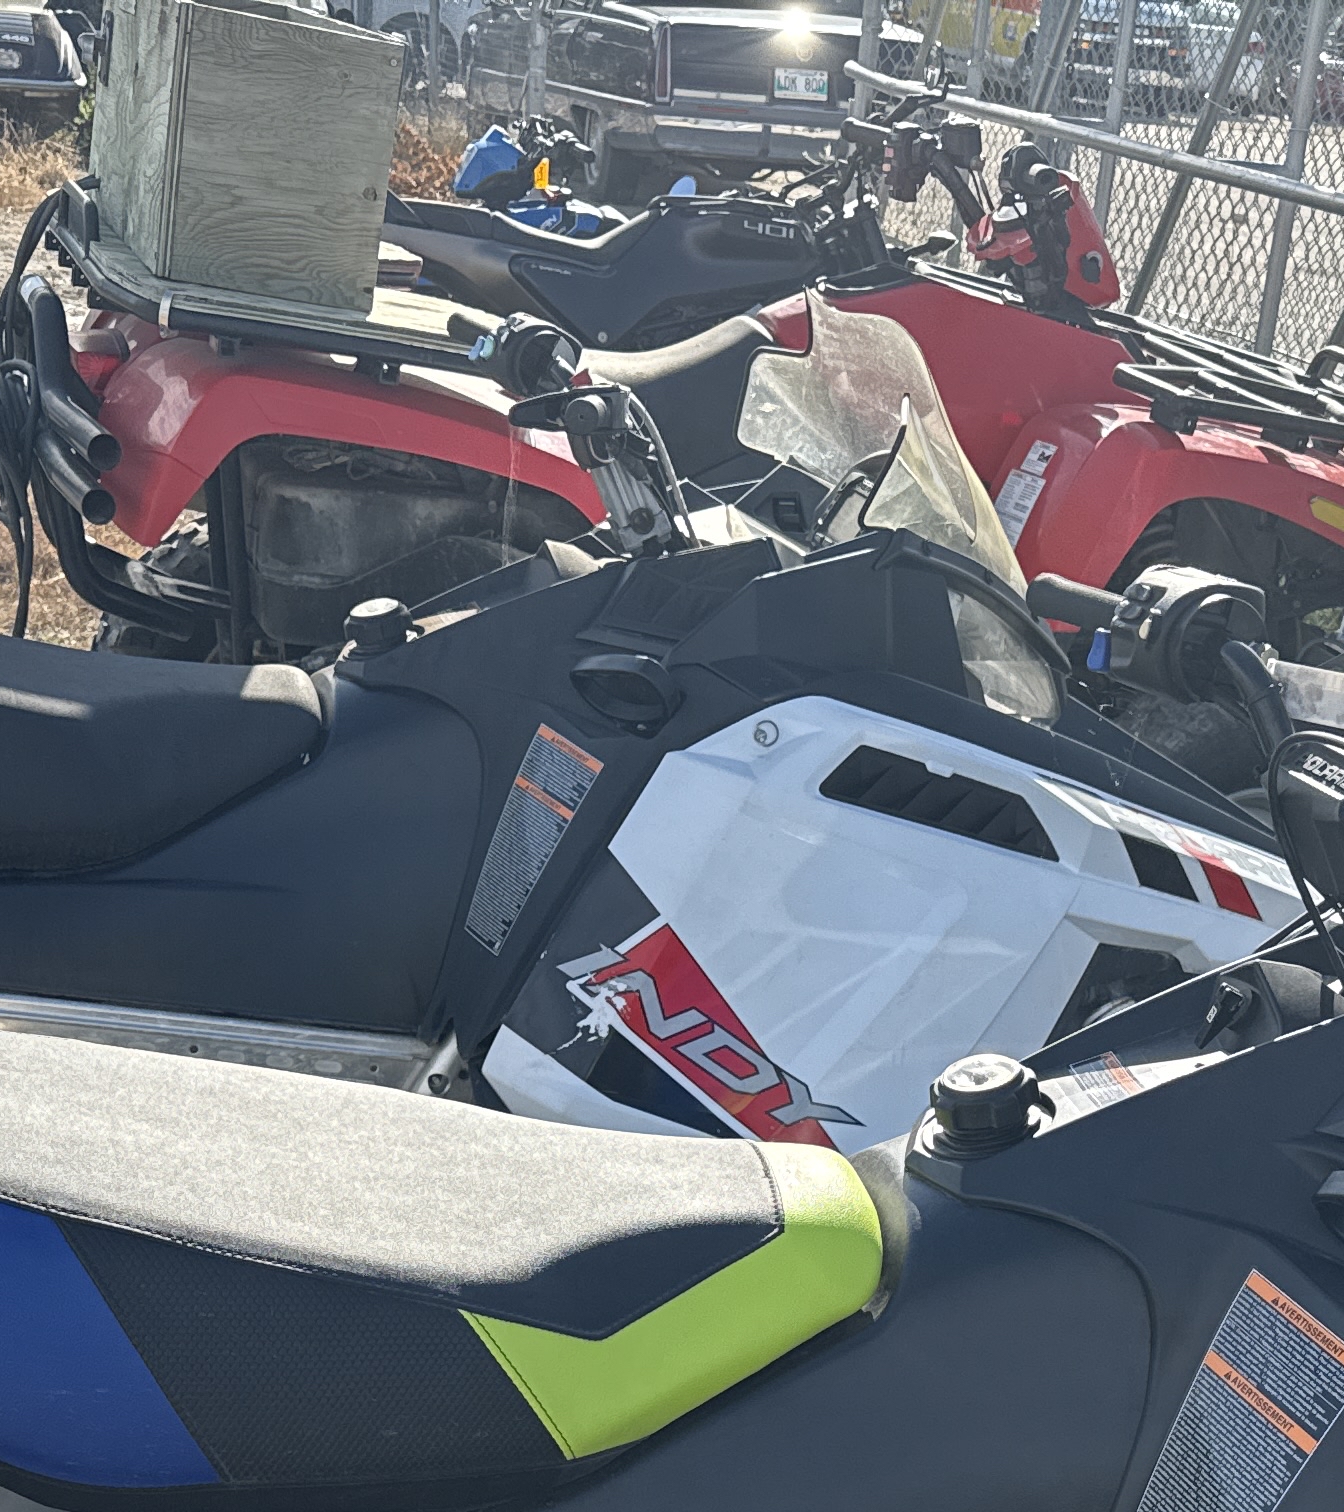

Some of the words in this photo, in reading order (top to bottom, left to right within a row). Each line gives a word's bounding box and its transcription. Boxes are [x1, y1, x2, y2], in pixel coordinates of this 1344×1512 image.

[804, 77, 826, 93] 800
[744, 220, 795, 239] 401
[556, 946, 866, 1127] INDY
[1231, 1376, 1295, 1433] AVERTISSEMENT
